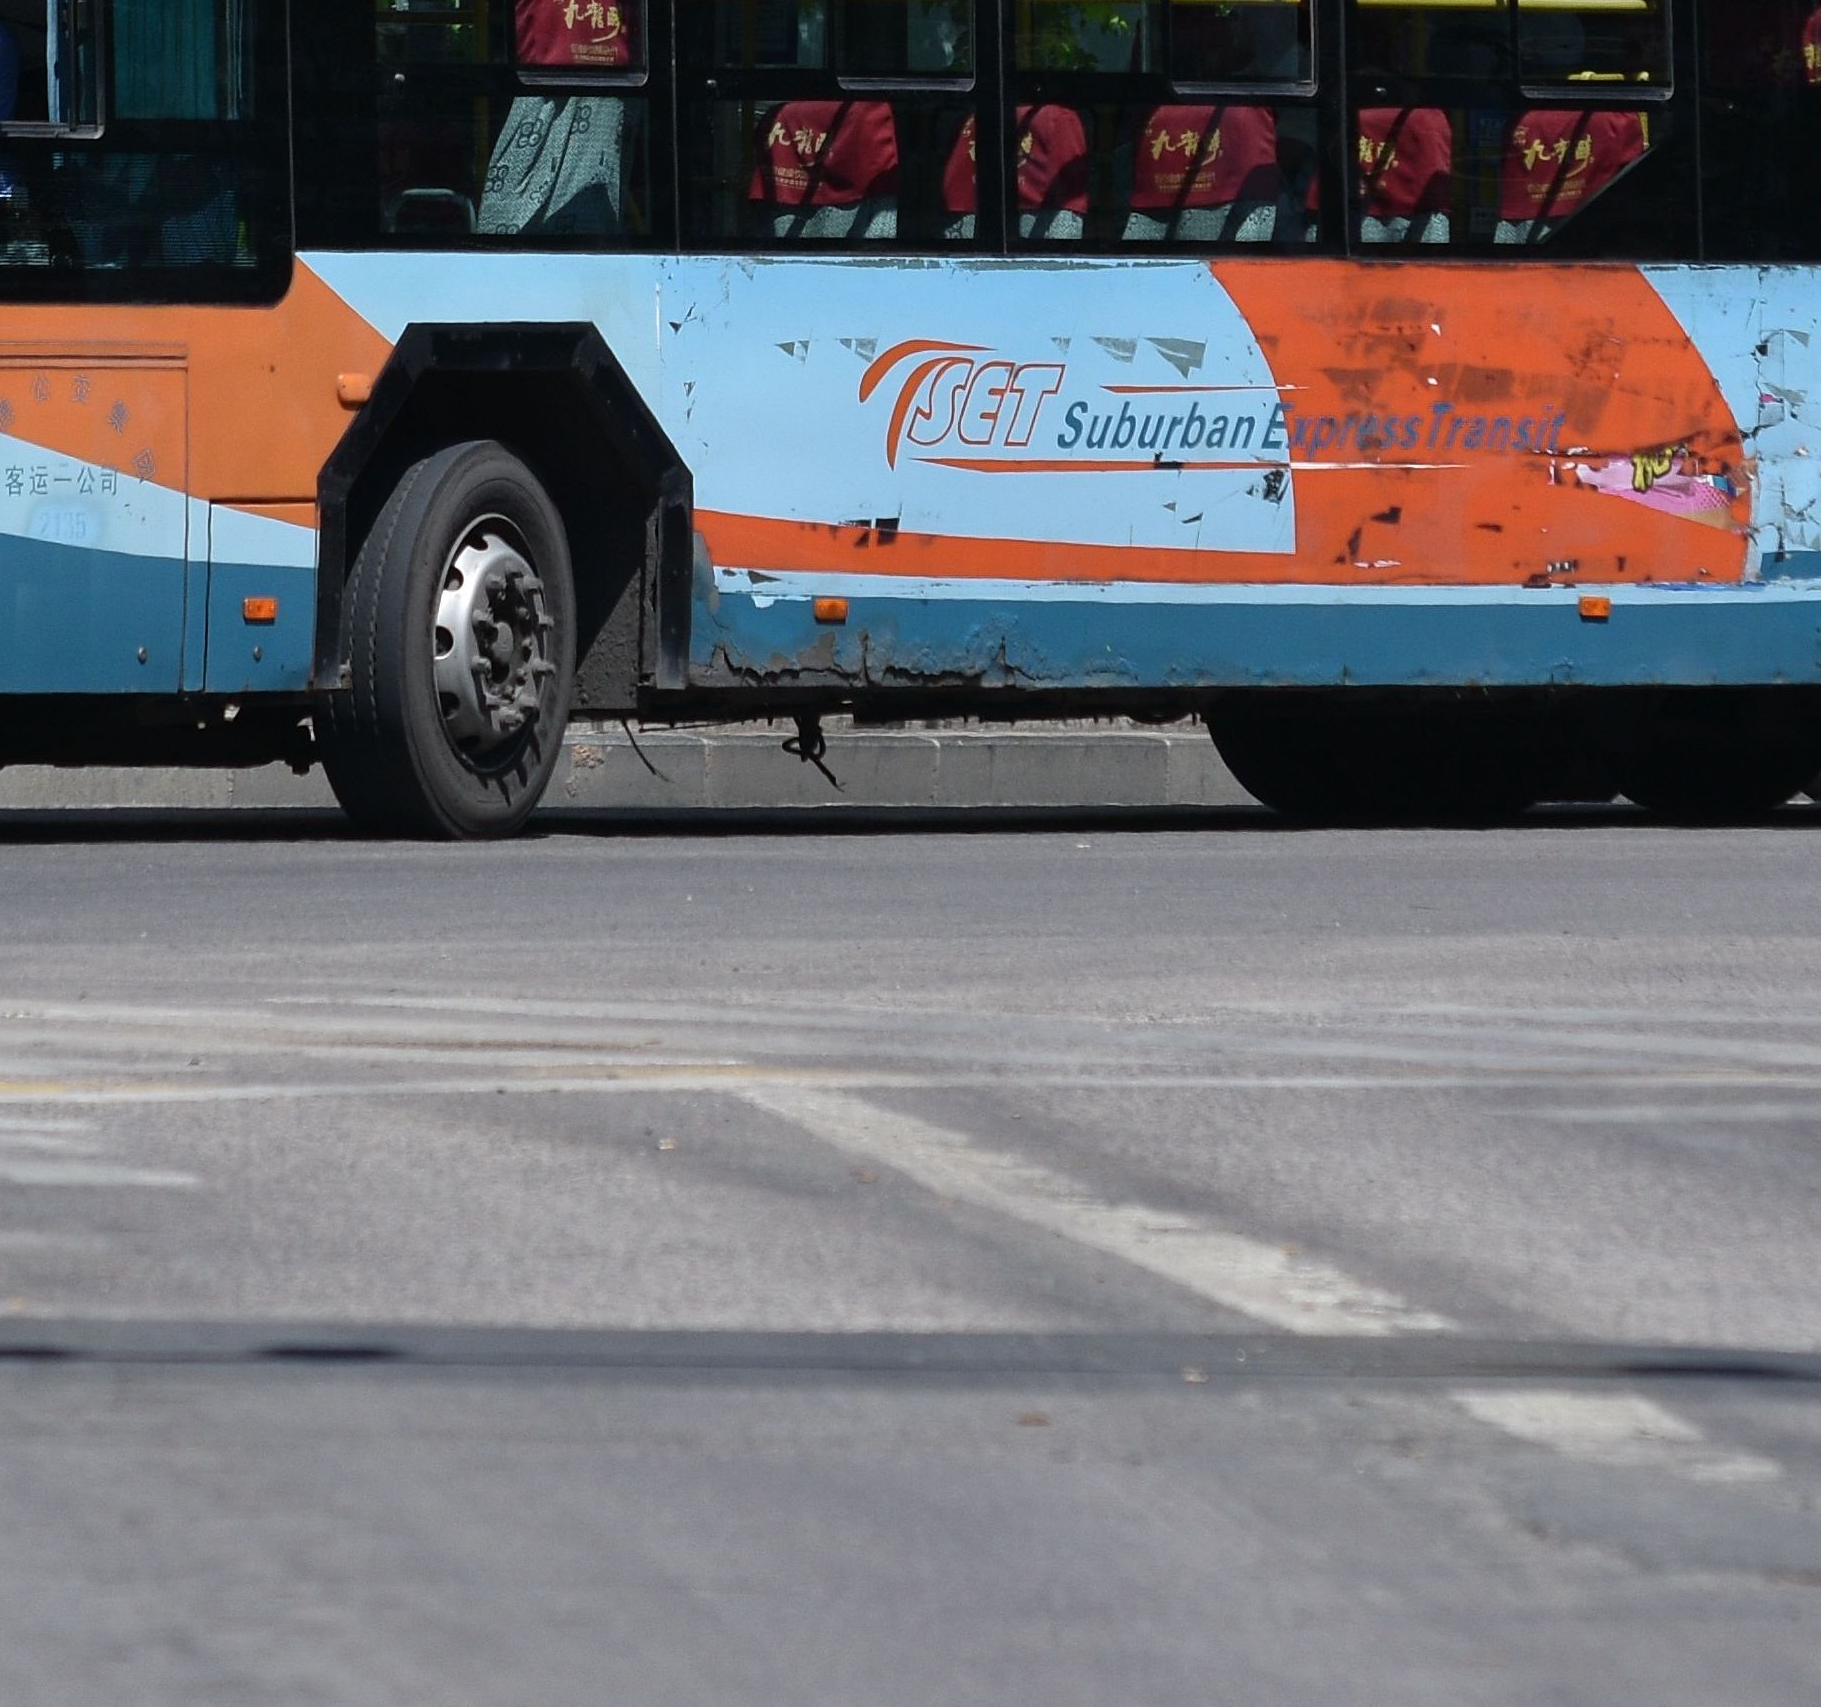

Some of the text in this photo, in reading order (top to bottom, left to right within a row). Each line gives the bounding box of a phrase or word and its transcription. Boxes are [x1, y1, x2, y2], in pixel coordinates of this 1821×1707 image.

[1057, 399, 1567, 461] Suburban Express Transit
